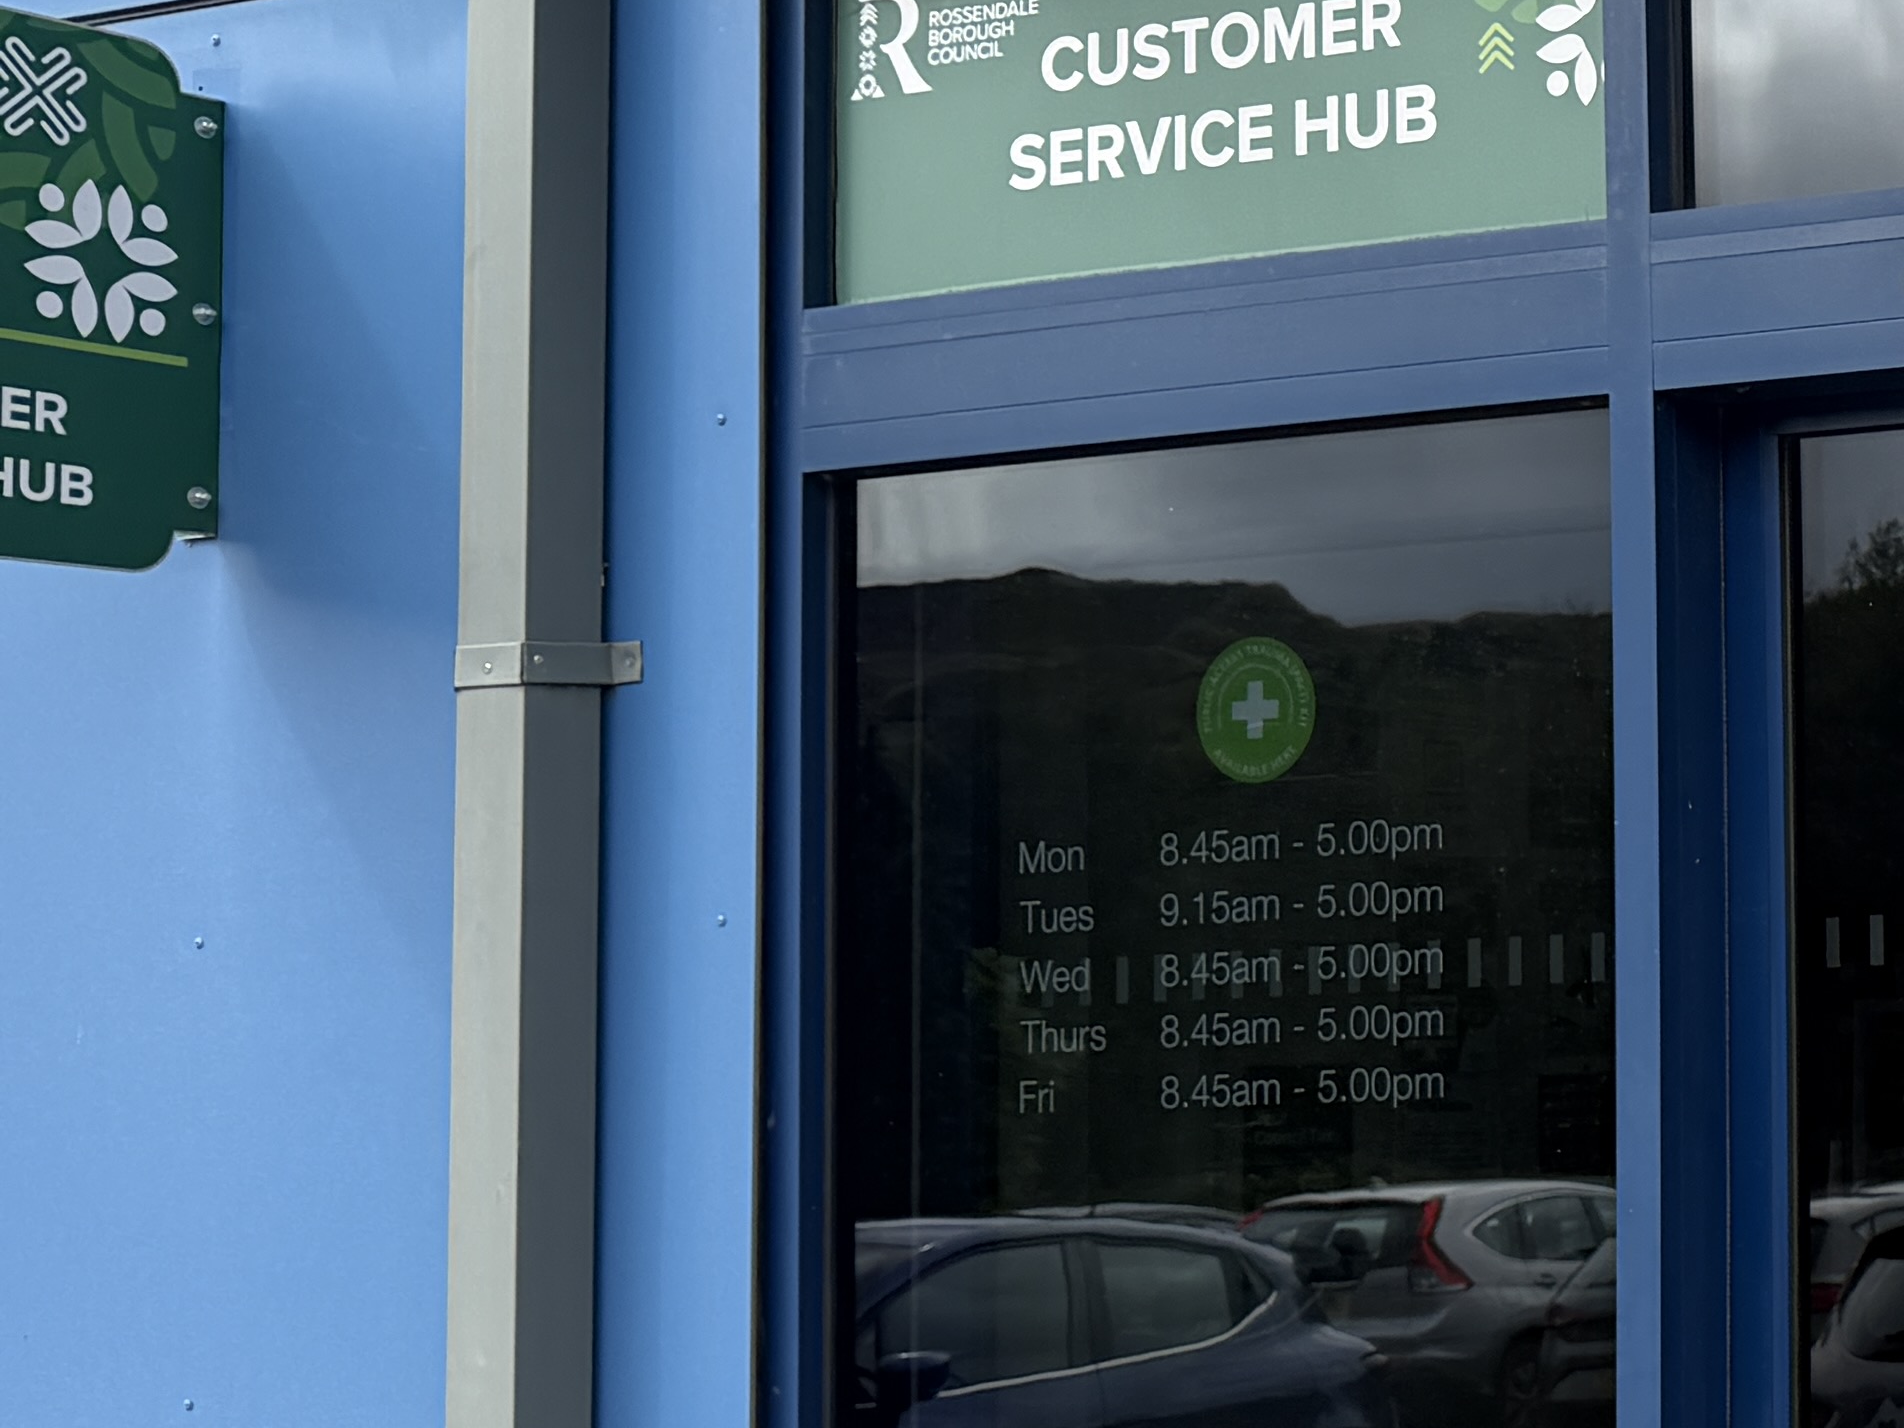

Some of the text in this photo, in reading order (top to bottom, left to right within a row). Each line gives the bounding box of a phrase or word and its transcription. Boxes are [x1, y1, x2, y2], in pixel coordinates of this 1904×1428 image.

[928, 19, 1015, 47] BOROUGH
[928, 41, 1004, 66] COUNCIL
[1009, 84, 1438, 192] SERVICE HUB
[0, 456, 94, 507] HUB
[1018, 839, 1086, 874] Mon
[1159, 830, 1280, 867] 8.45am
[1316, 819, 1444, 865] 5.00pm
[1021, 900, 1095, 934] Tues
[1159, 891, 1280, 927] 9.15am
[1316, 881, 1444, 926] 5.00pm
[1020, 958, 1092, 993] Wed
[1159, 950, 1281, 989] 8.45am
[1316, 943, 1444, 989] 5.00pm
[1020, 1019, 1107, 1054] Thurs
[1160, 1013, 1281, 1050] 8.45am
[1316, 1005, 1445, 1050] 5.00pm
[1019, 1079, 1055, 1114] Fri
[1160, 1074, 1281, 1112] 8.45am
[1316, 1067, 1445, 1112] 5.00pm
